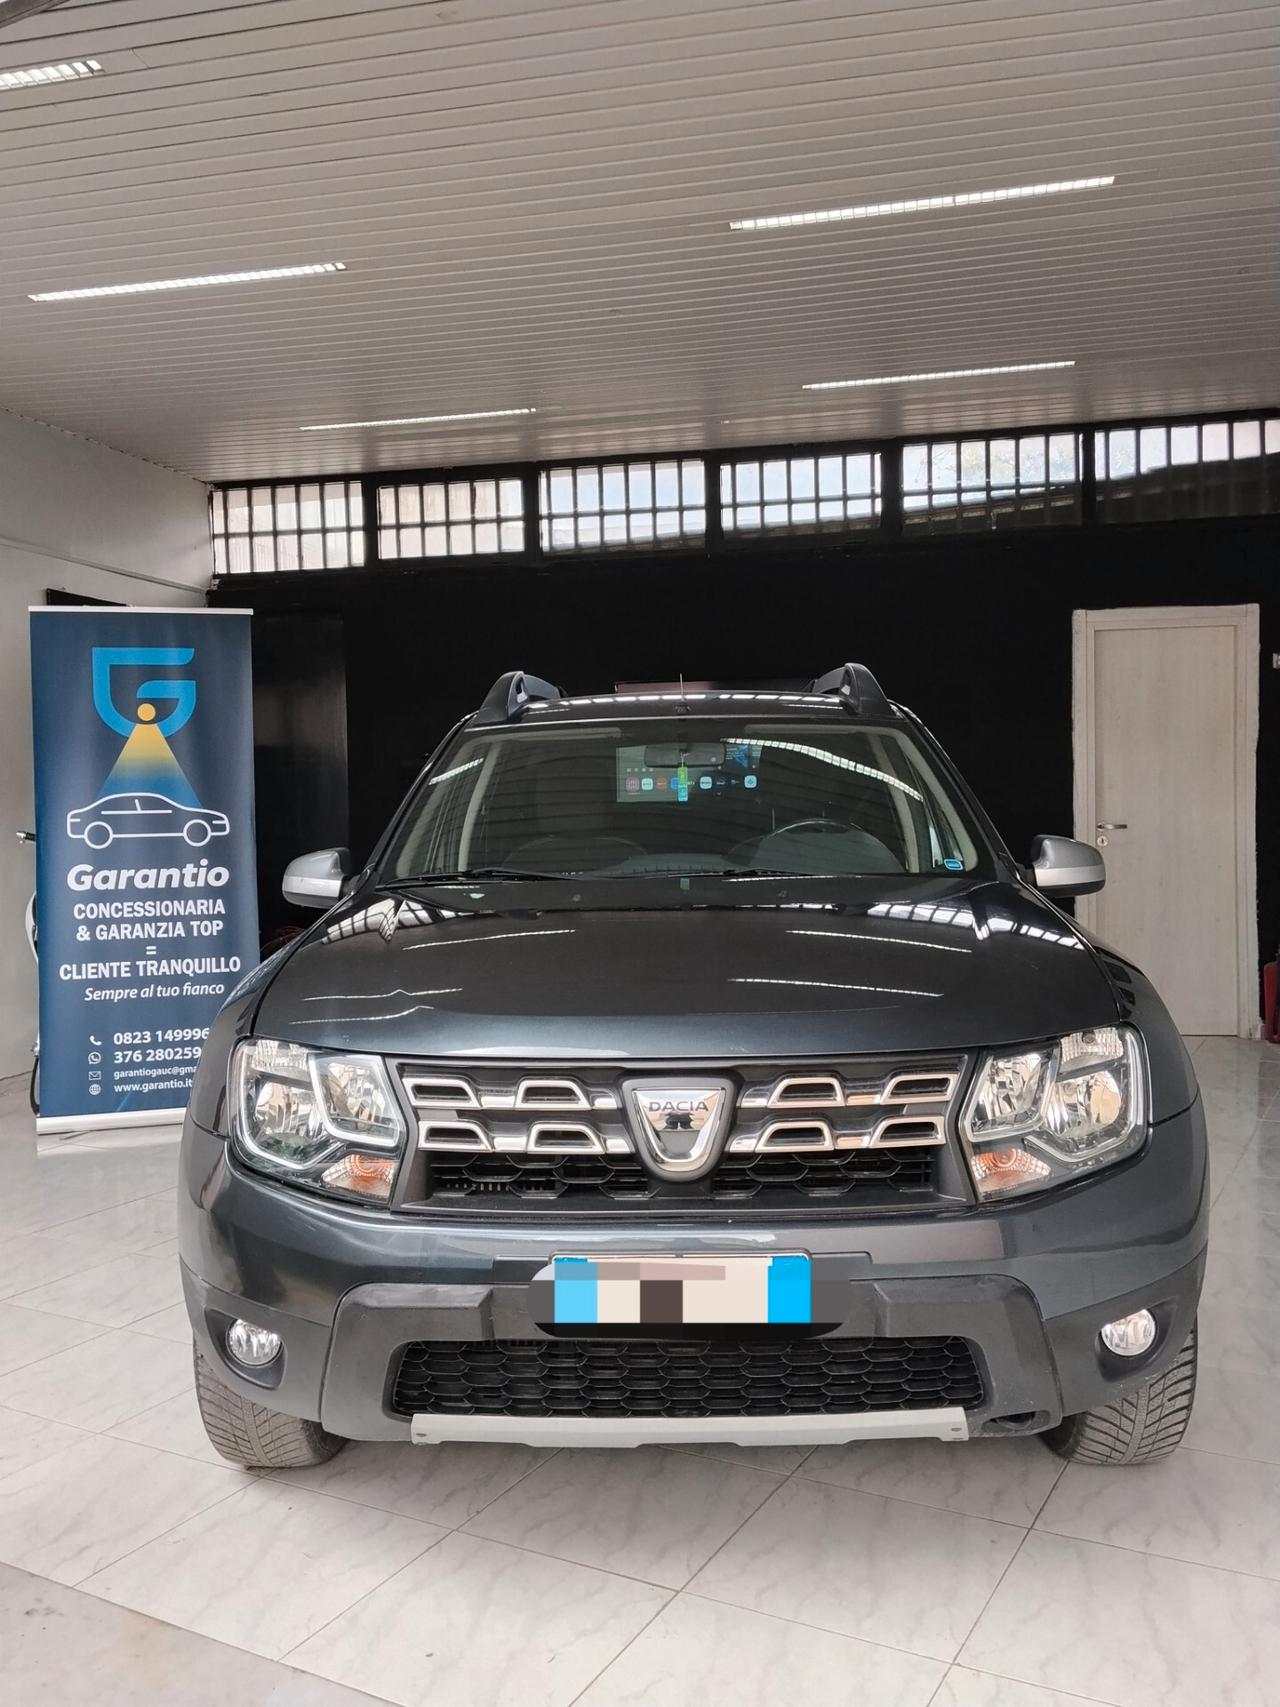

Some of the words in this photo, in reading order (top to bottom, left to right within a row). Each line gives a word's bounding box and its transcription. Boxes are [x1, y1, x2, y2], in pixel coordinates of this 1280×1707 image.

[67, 858, 230, 891] Garantio
[74, 899, 226, 920] CONCESSIONARIA
[76, 925, 91, 941] &
[95, 922, 186, 940] GARANZIA
[190, 920, 224, 937] TOP
[59, 962, 131, 980] CLIENTE
[136, 956, 241, 977] TRANQUILLO
[84, 986, 138, 1002] Sempre
[140, 984, 154, 998] al
[157, 983, 181, 997] tuo
[182, 981, 225, 996] fianco
[113, 1031, 151, 1045] 0823
[113, 1050, 142, 1064] 376
[648, 1101, 709, 1112] DACIA
